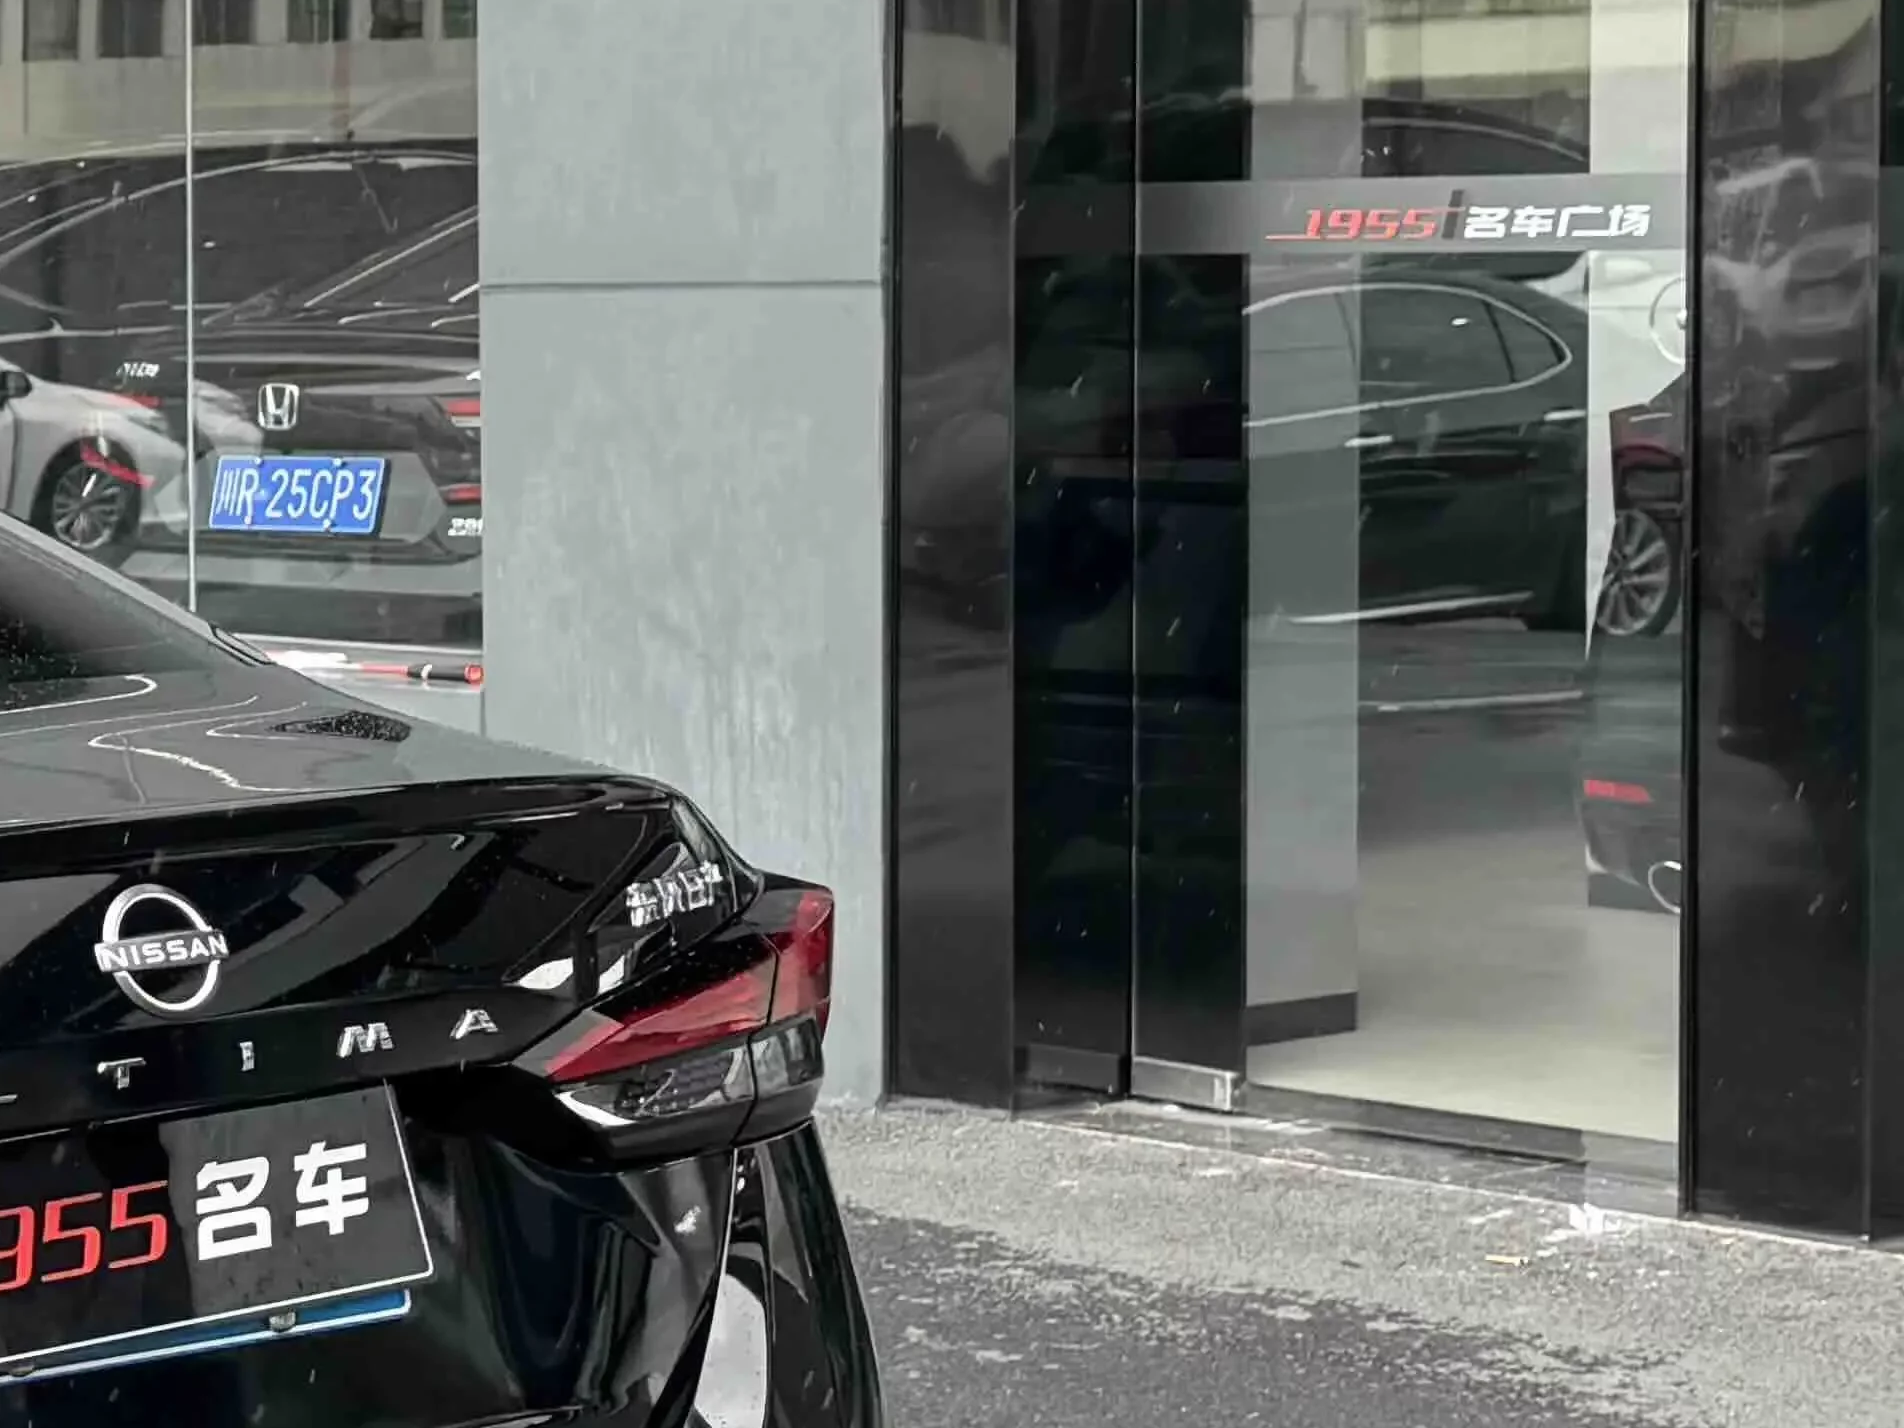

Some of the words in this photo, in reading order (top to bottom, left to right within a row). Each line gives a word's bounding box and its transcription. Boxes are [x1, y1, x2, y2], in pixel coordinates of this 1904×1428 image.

[1304, 208, 1438, 240] 1955
[1463, 205, 1651, 239] 名车广场
[97, 932, 229, 969] NISSAN
[195, 1139, 370, 1261] 名车
